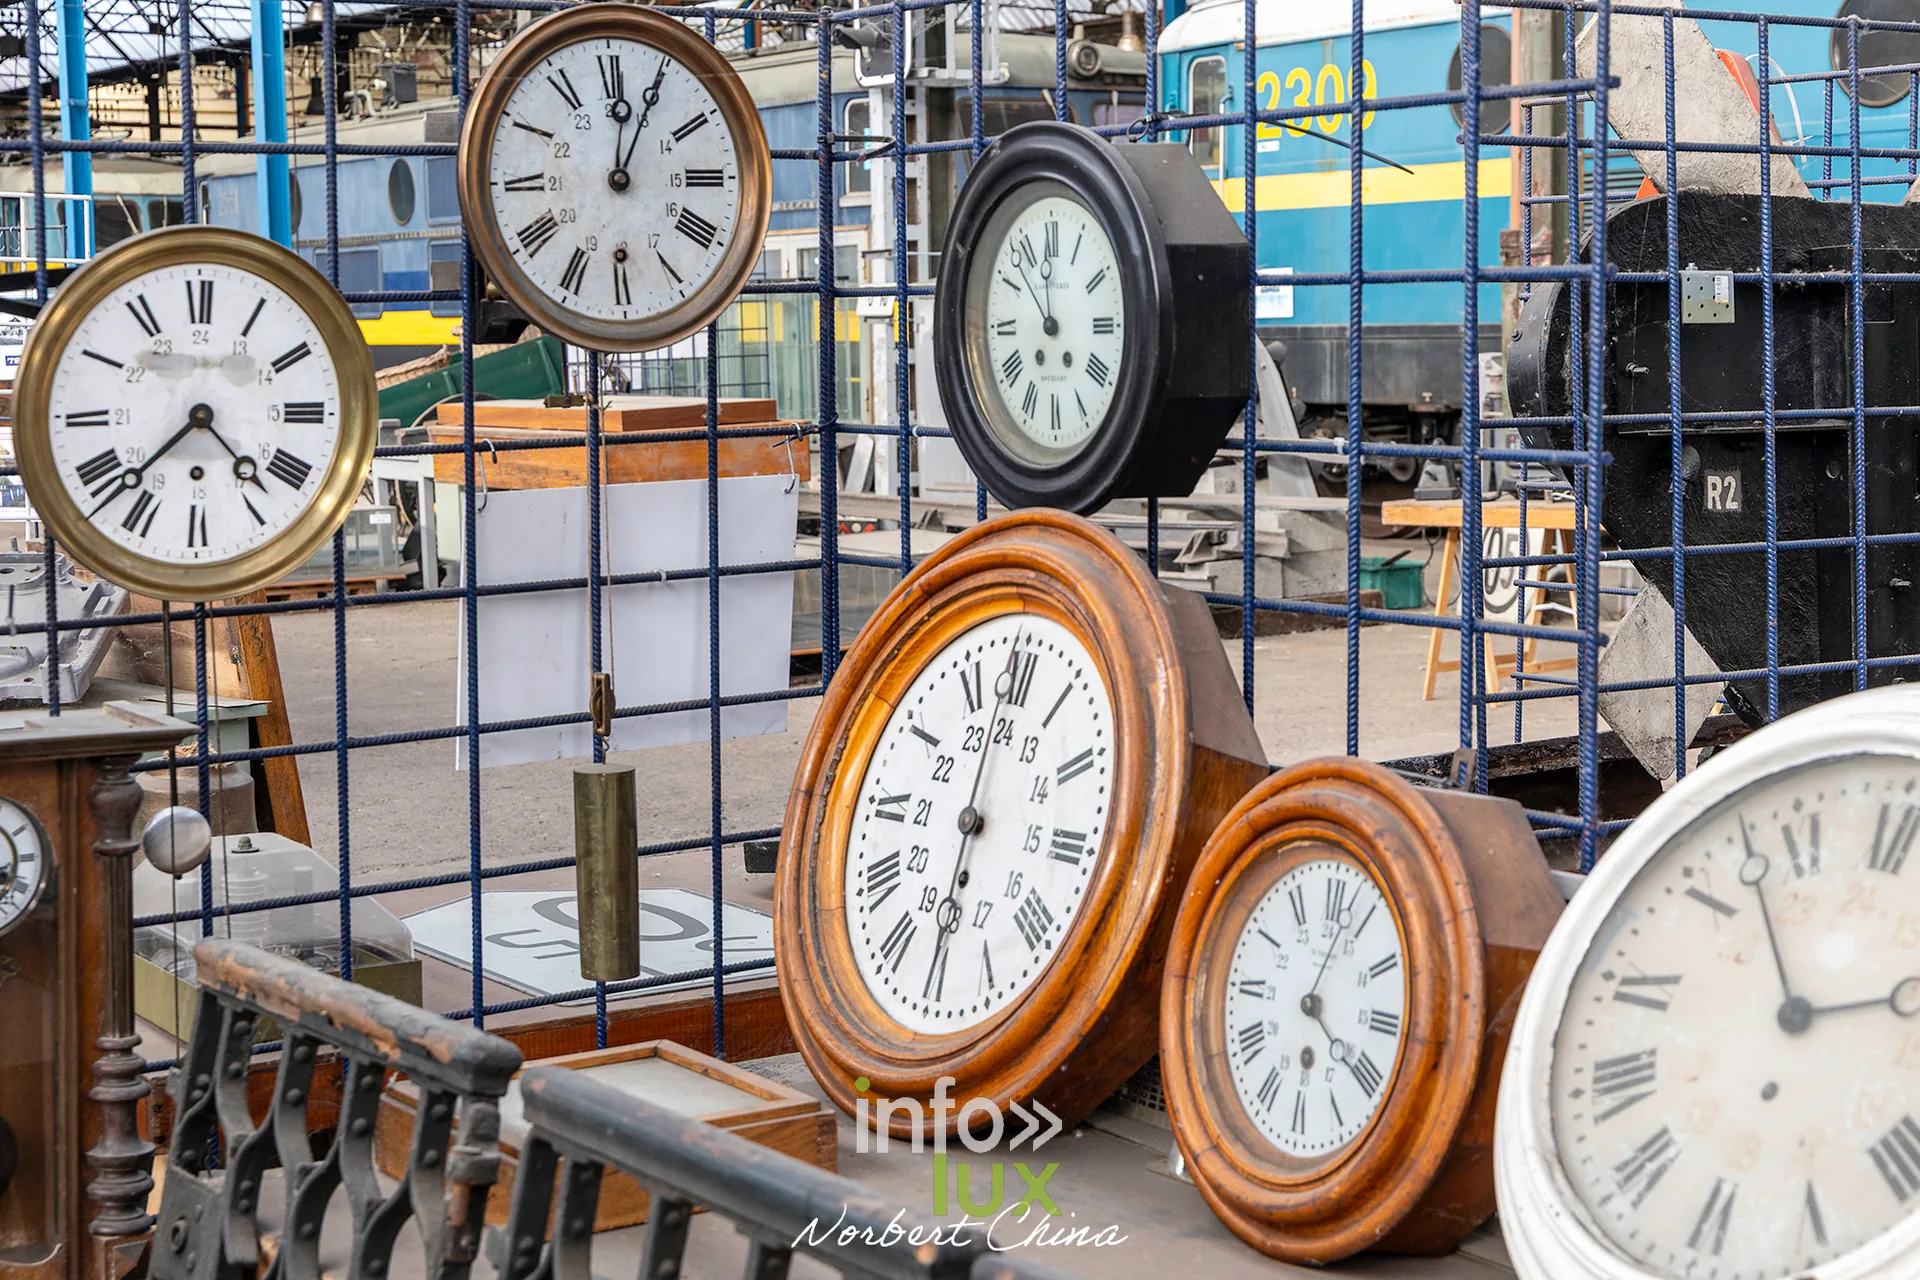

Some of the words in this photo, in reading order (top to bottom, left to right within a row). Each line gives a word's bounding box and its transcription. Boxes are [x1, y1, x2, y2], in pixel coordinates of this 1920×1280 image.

[547, 68, 584, 116] XI
[595, 54, 620, 100] XII
[513, 112, 554, 146] X
[575, 115, 591, 130] 23
[670, 112, 709, 143] II
[554, 143, 570, 158] 22
[660, 140, 673, 154] 14
[503, 172, 544, 192] IX
[549, 177, 563, 191] 21
[670, 174, 682, 187] 15
[685, 168, 724, 187] III
[559, 209, 576, 224] 20
[666, 203, 678, 217] 16
[516, 208, 560, 258] VIII
[585, 236, 598, 251] 19
[648, 233, 660, 248] 17
[675, 207, 719, 250] IIII
[1020, 234, 1037, 268] XI
[1071, 233, 1082, 265] I
[559, 246, 591, 296] VII
[613, 261, 632, 305] VI
[656, 249, 684, 290] V
[1086, 269, 1106, 294] II
[186, 280, 213, 324] XII
[1002, 274, 1021, 298] X
[126, 294, 162, 337] XI
[242, 298, 266, 337] I
[997, 318, 1016, 335] IX
[1093, 317, 1114, 334] III
[153, 340, 172, 354] 23
[192, 330, 209, 344] 24
[232, 340, 247, 356] 13
[81, 349, 123, 369] X
[272, 341, 311, 373] II
[1002, 349, 1023, 388] VIII
[1086, 352, 1109, 387] IIII
[126, 366, 145, 383] 22
[257, 368, 273, 384] 14
[267, 404, 280, 420] 15
[284, 402, 324, 423] III
[1022, 380, 1039, 419] VII
[1051, 393, 1061, 429] VI
[1074, 387, 1087, 420] V
[66, 410, 108, 427] IX
[115, 409, 131, 425] 21
[126, 447, 145, 463] 20
[258, 442, 270, 460] 16
[152, 473, 165, 489] 19
[266, 448, 312, 490] IIII
[1706, 475, 1739, 511] R2
[188, 505, 208, 547] VI
[961, 660, 983, 719] XI
[1003, 651, 1040, 709] XII
[1043, 683, 1074, 728] I
[910, 712, 941, 759] X
[962, 726, 985, 752] 23
[994, 718, 1014, 745] 24
[1019, 736, 1039, 763] 13
[932, 756, 954, 782] 22
[1057, 747, 1094, 785] II
[875, 788, 912, 822] IX
[1029, 776, 1048, 803] 14
[913, 799, 932, 826] 21
[1023, 825, 1042, 852] 15
[1048, 827, 1087, 865] III
[1781, 811, 1821, 878] XI
[19, 853, 34, 862] III
[907, 845, 929, 873] 20
[867, 850, 901, 912] VIII
[1004, 871, 1022, 899] 16
[919, 886, 937, 913] 19
[972, 900, 993, 928] 17
[1288, 884, 1306, 927] XI
[1326, 878, 1346, 922] XII
[1684, 867, 1740, 932] X
[1014, 886, 1054, 951] IIII
[1355, 905, 1376, 938] I
[880, 911, 917, 973] VII
[1258, 920, 1282, 958] X
[978, 940, 995, 996] V
[1369, 953, 1398, 979] II
[1239, 972, 1266, 998] IX
[1612, 963, 1685, 1012] IX
[1370, 1009, 1399, 1036] III
[1239, 1021, 1267, 1066] VIII
[1257, 1066, 1283, 1112] VII
[1352, 1051, 1383, 1100] IIII
[1593, 1047, 1657, 1127] VIII
[1291, 1090, 1306, 1134] VI
[1330, 1088, 1343, 1132] V
[1686, 1176, 1738, 1256] VI
[1796, 1178, 1829, 1256] V
